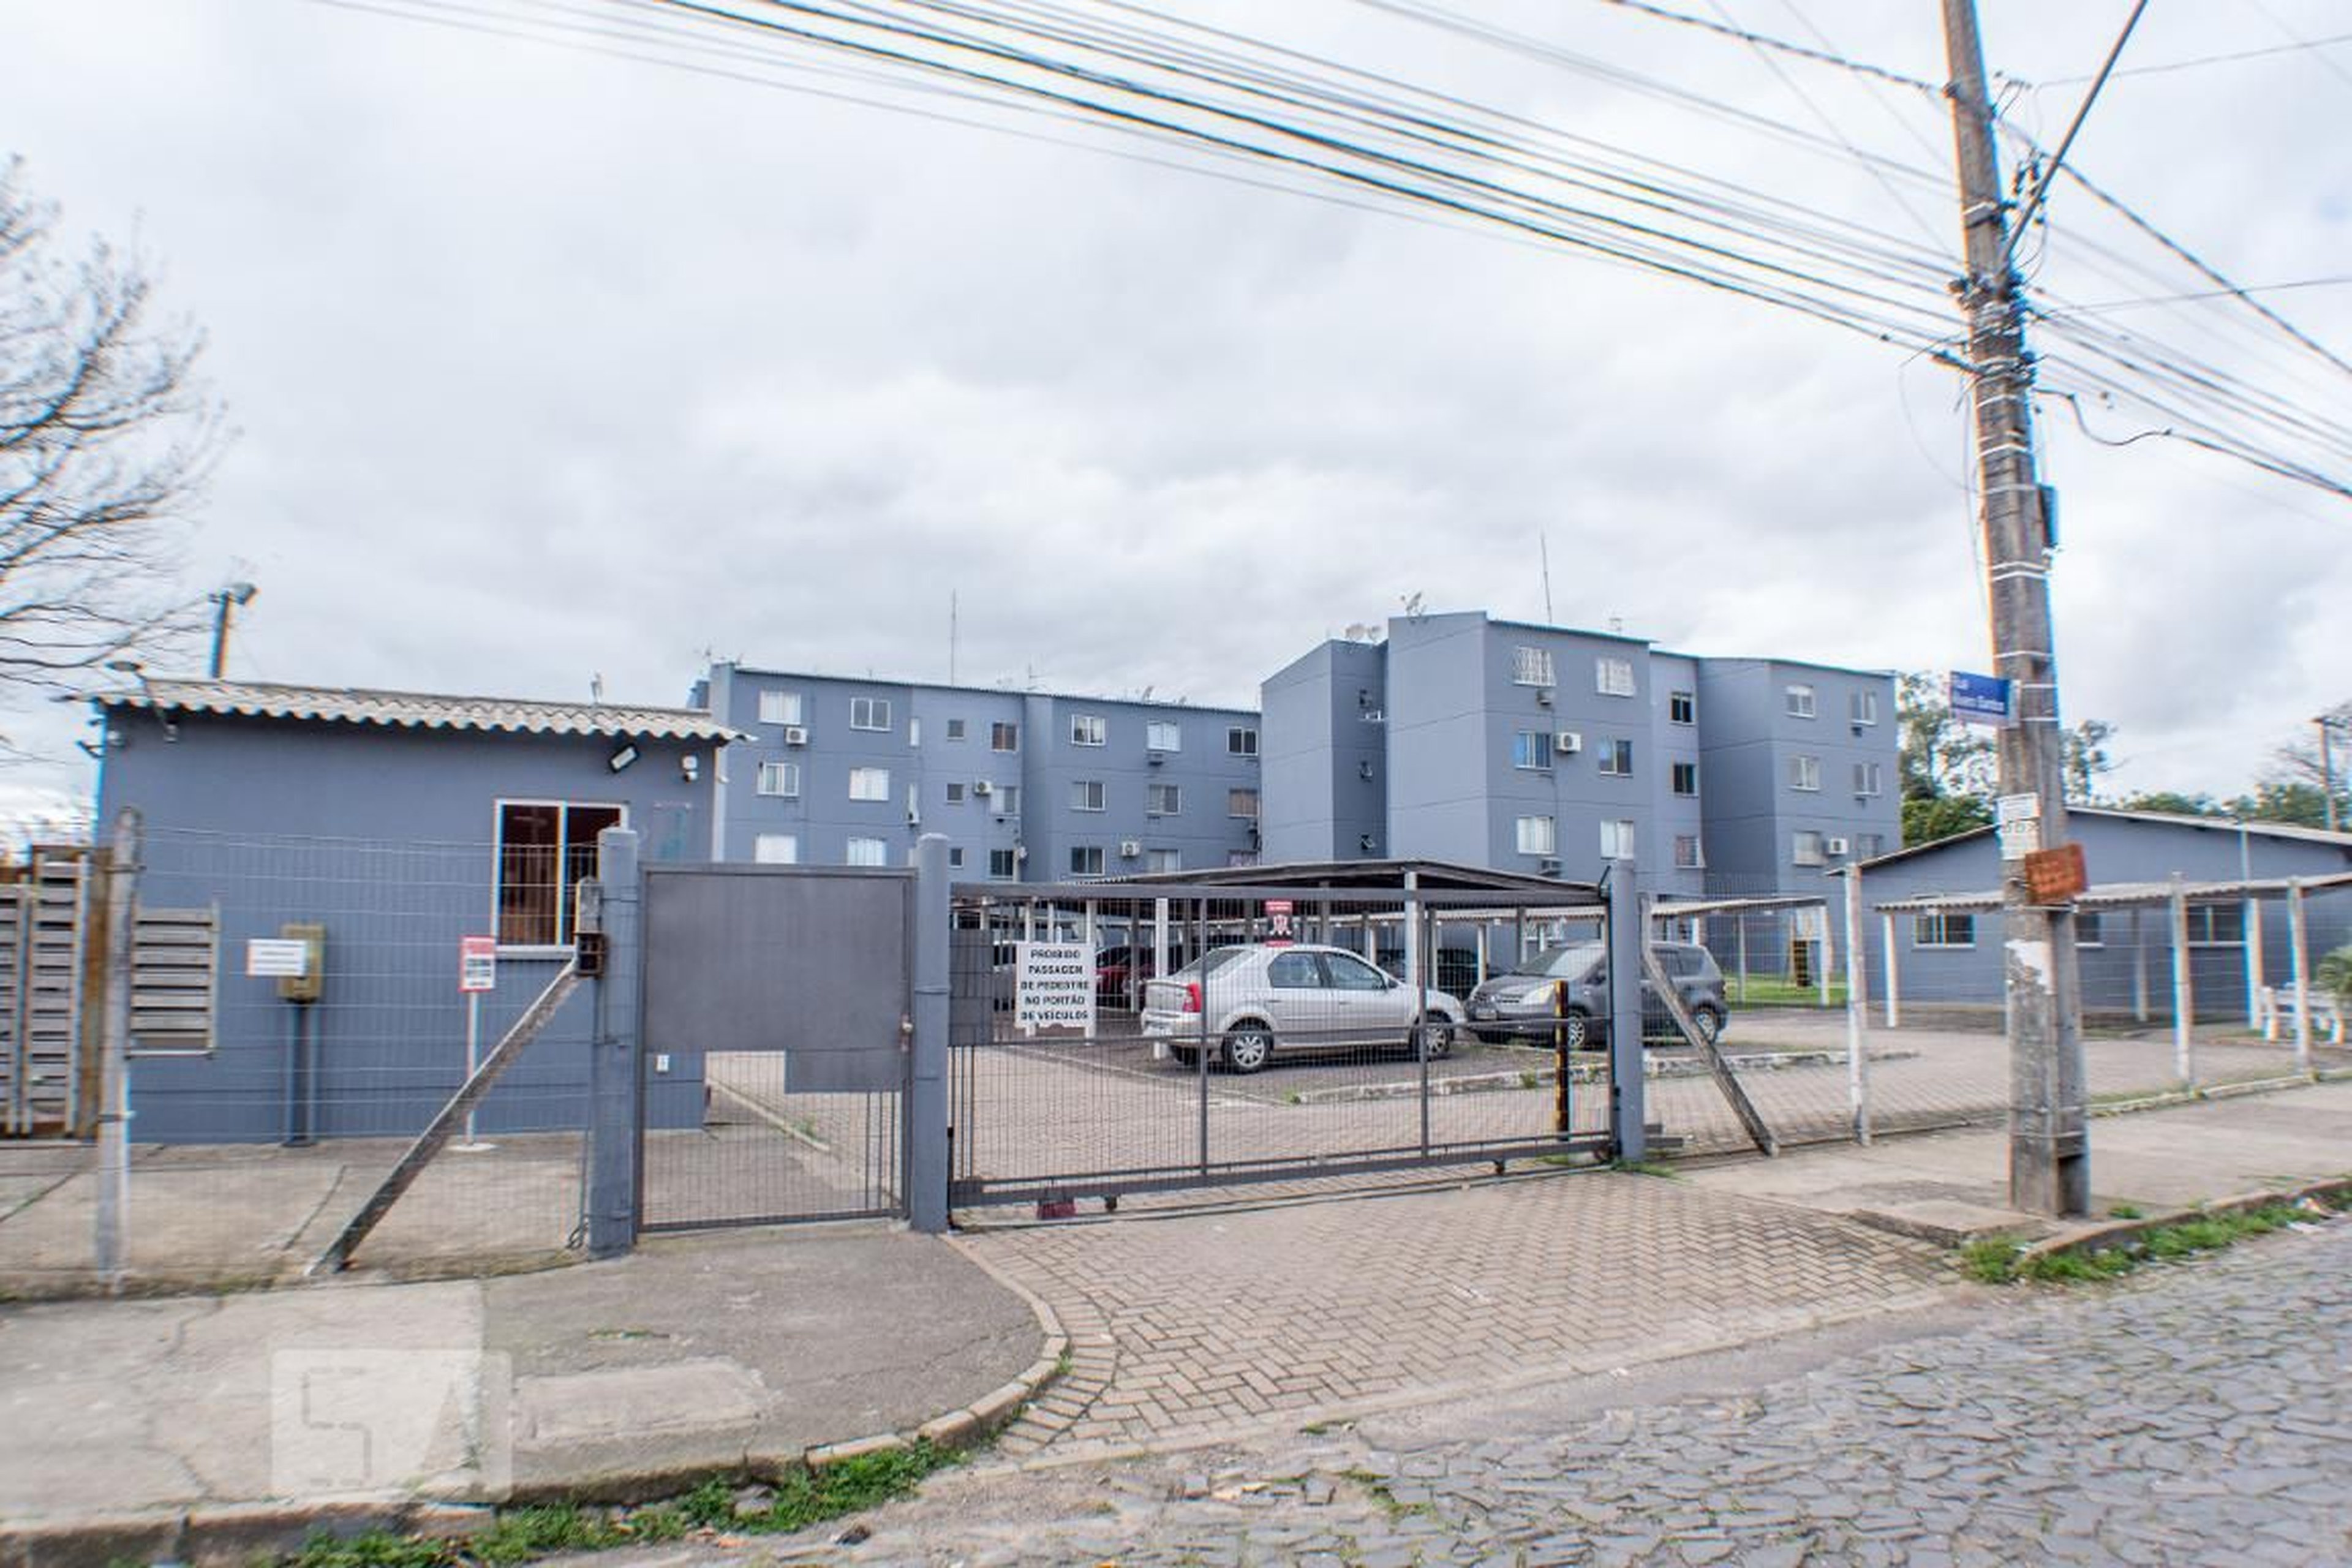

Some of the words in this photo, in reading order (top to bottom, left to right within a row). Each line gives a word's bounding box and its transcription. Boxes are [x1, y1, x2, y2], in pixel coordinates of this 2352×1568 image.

[1030, 949, 1080, 959] PROIBIDO
[1028, 965, 1083, 974] PASSAGEM
[1020, 981, 1034, 990] DE
[1037, 981, 1089, 990] PEDESTRE
[1025, 996, 1040, 1005] NO
[1021, 1012, 1035, 1020] DE
